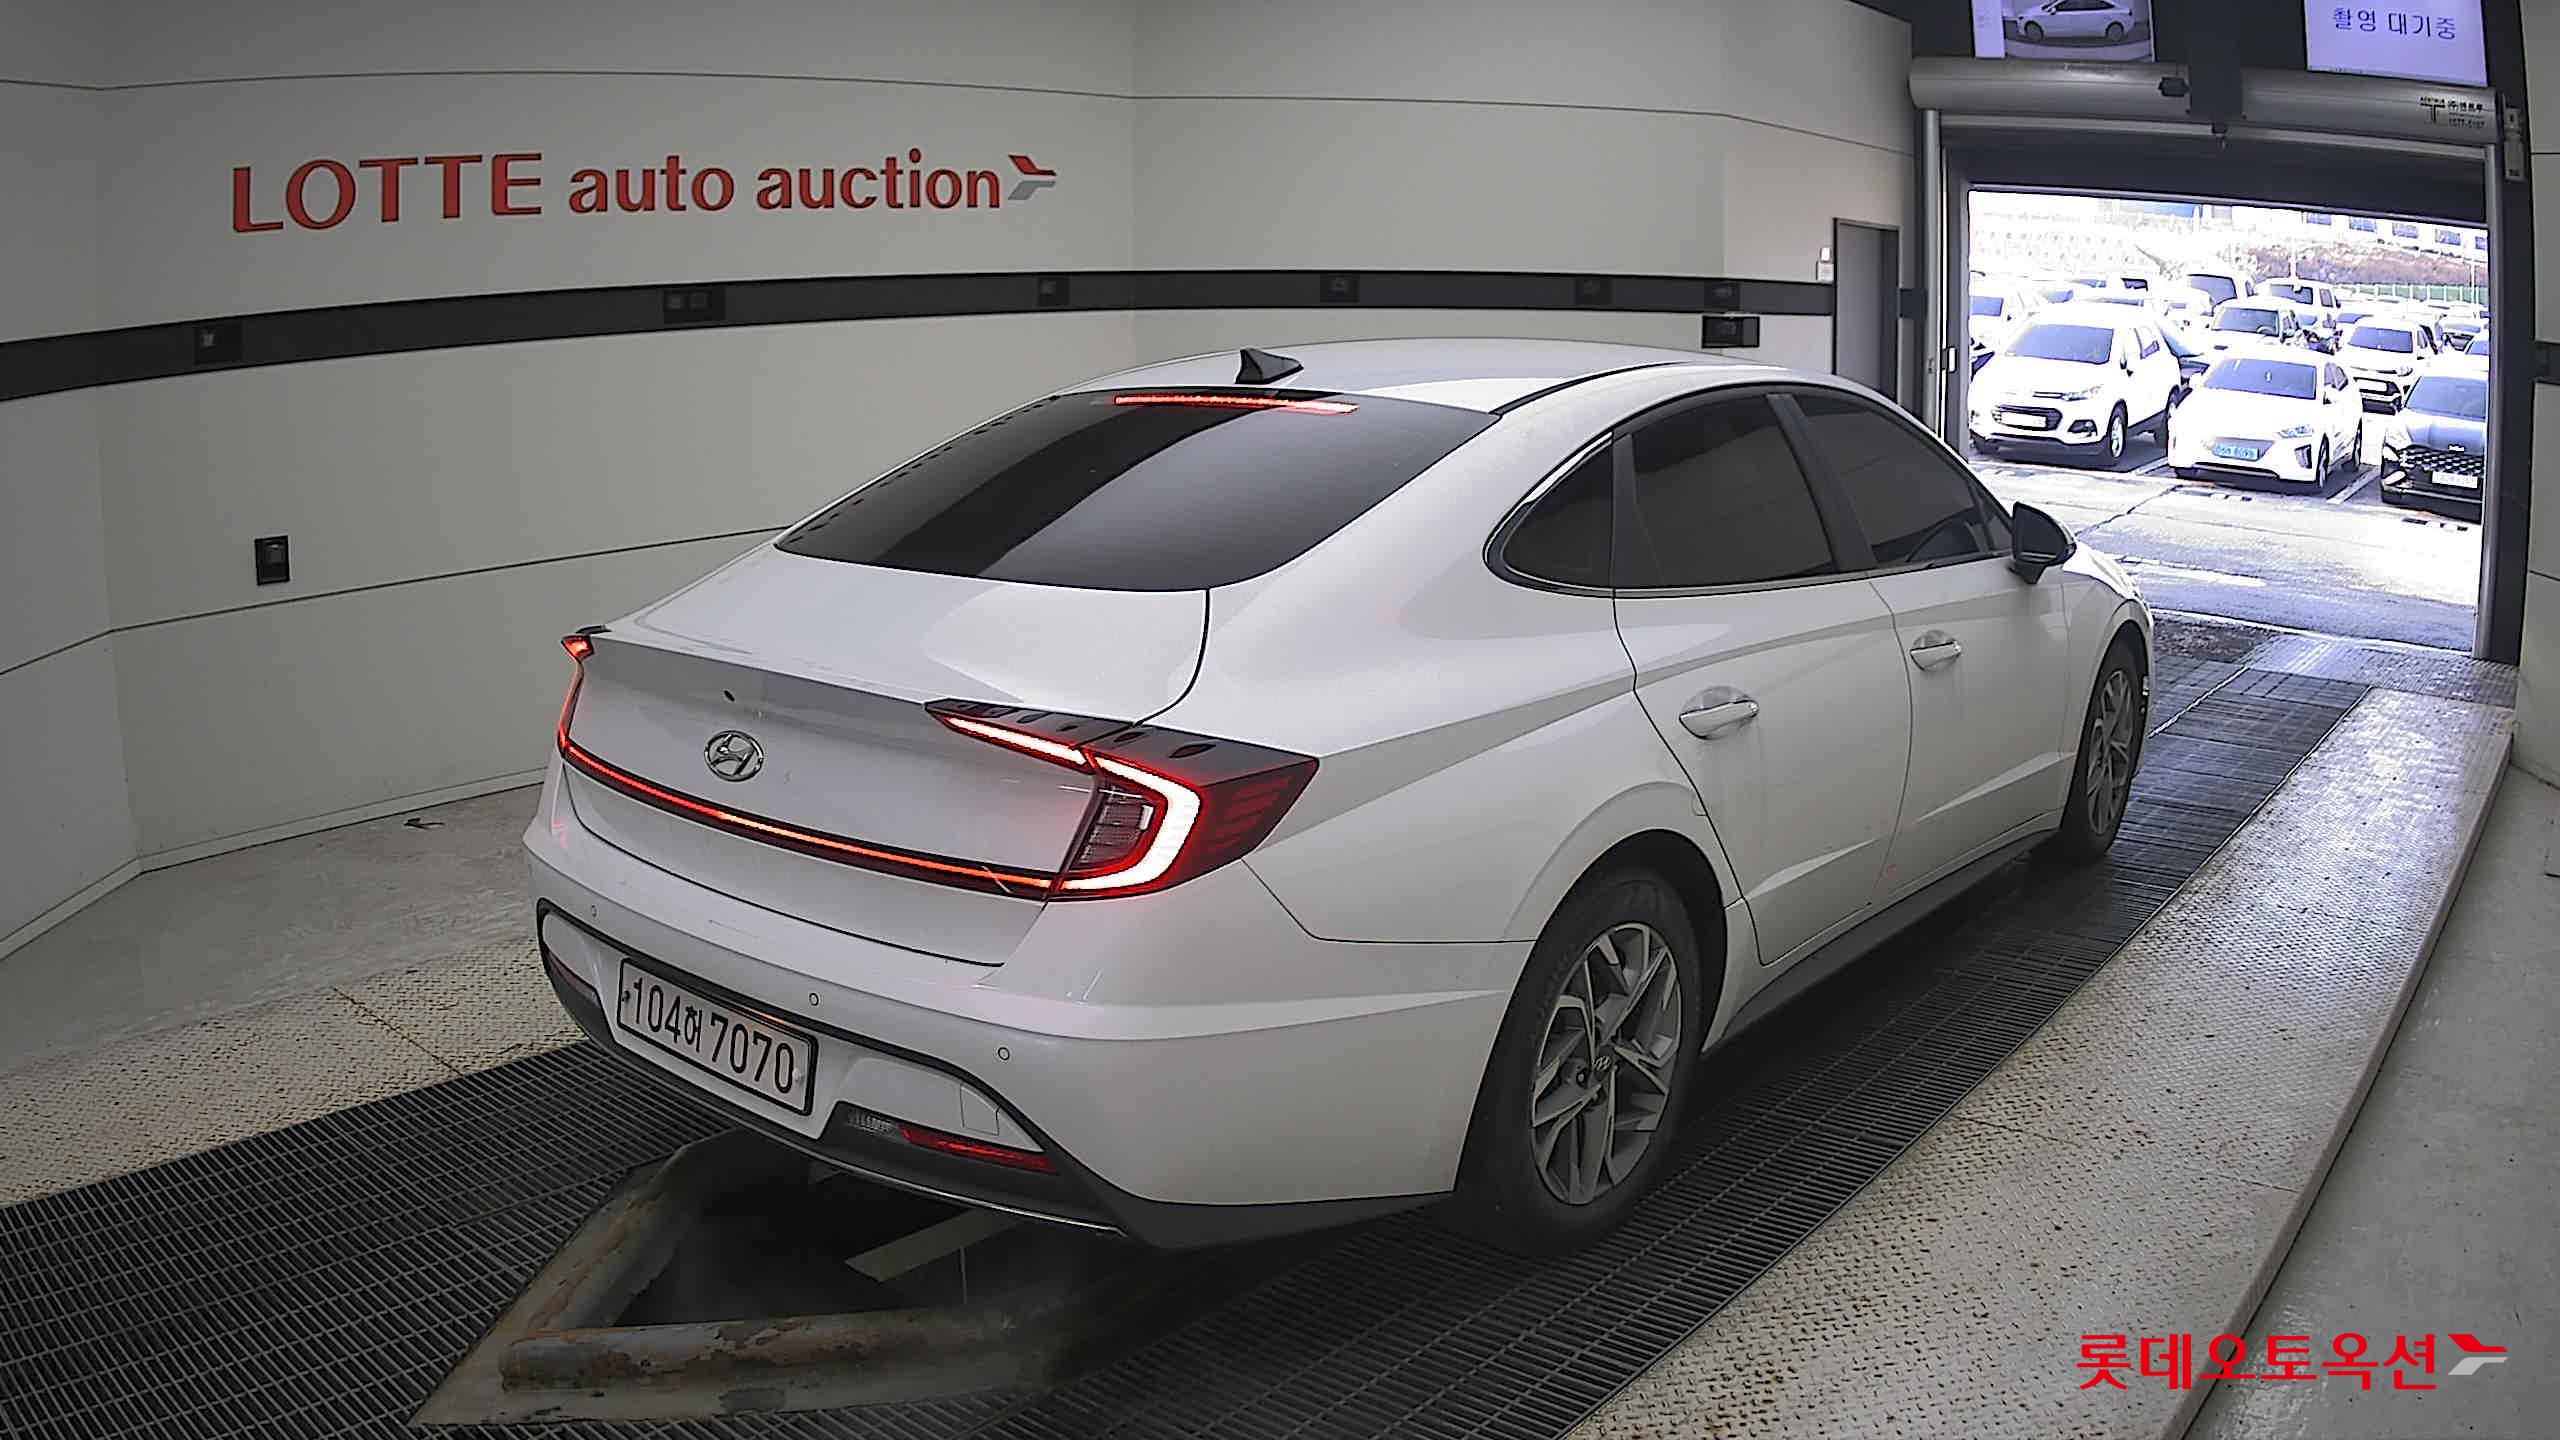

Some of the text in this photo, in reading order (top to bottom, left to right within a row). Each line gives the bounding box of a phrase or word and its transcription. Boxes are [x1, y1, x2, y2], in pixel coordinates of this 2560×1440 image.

[2334, 8, 2456, 40] 촬영 대기중
[232, 147, 1002, 232] LOTTE auto auction
[710, 1011, 795, 1094] 7070
